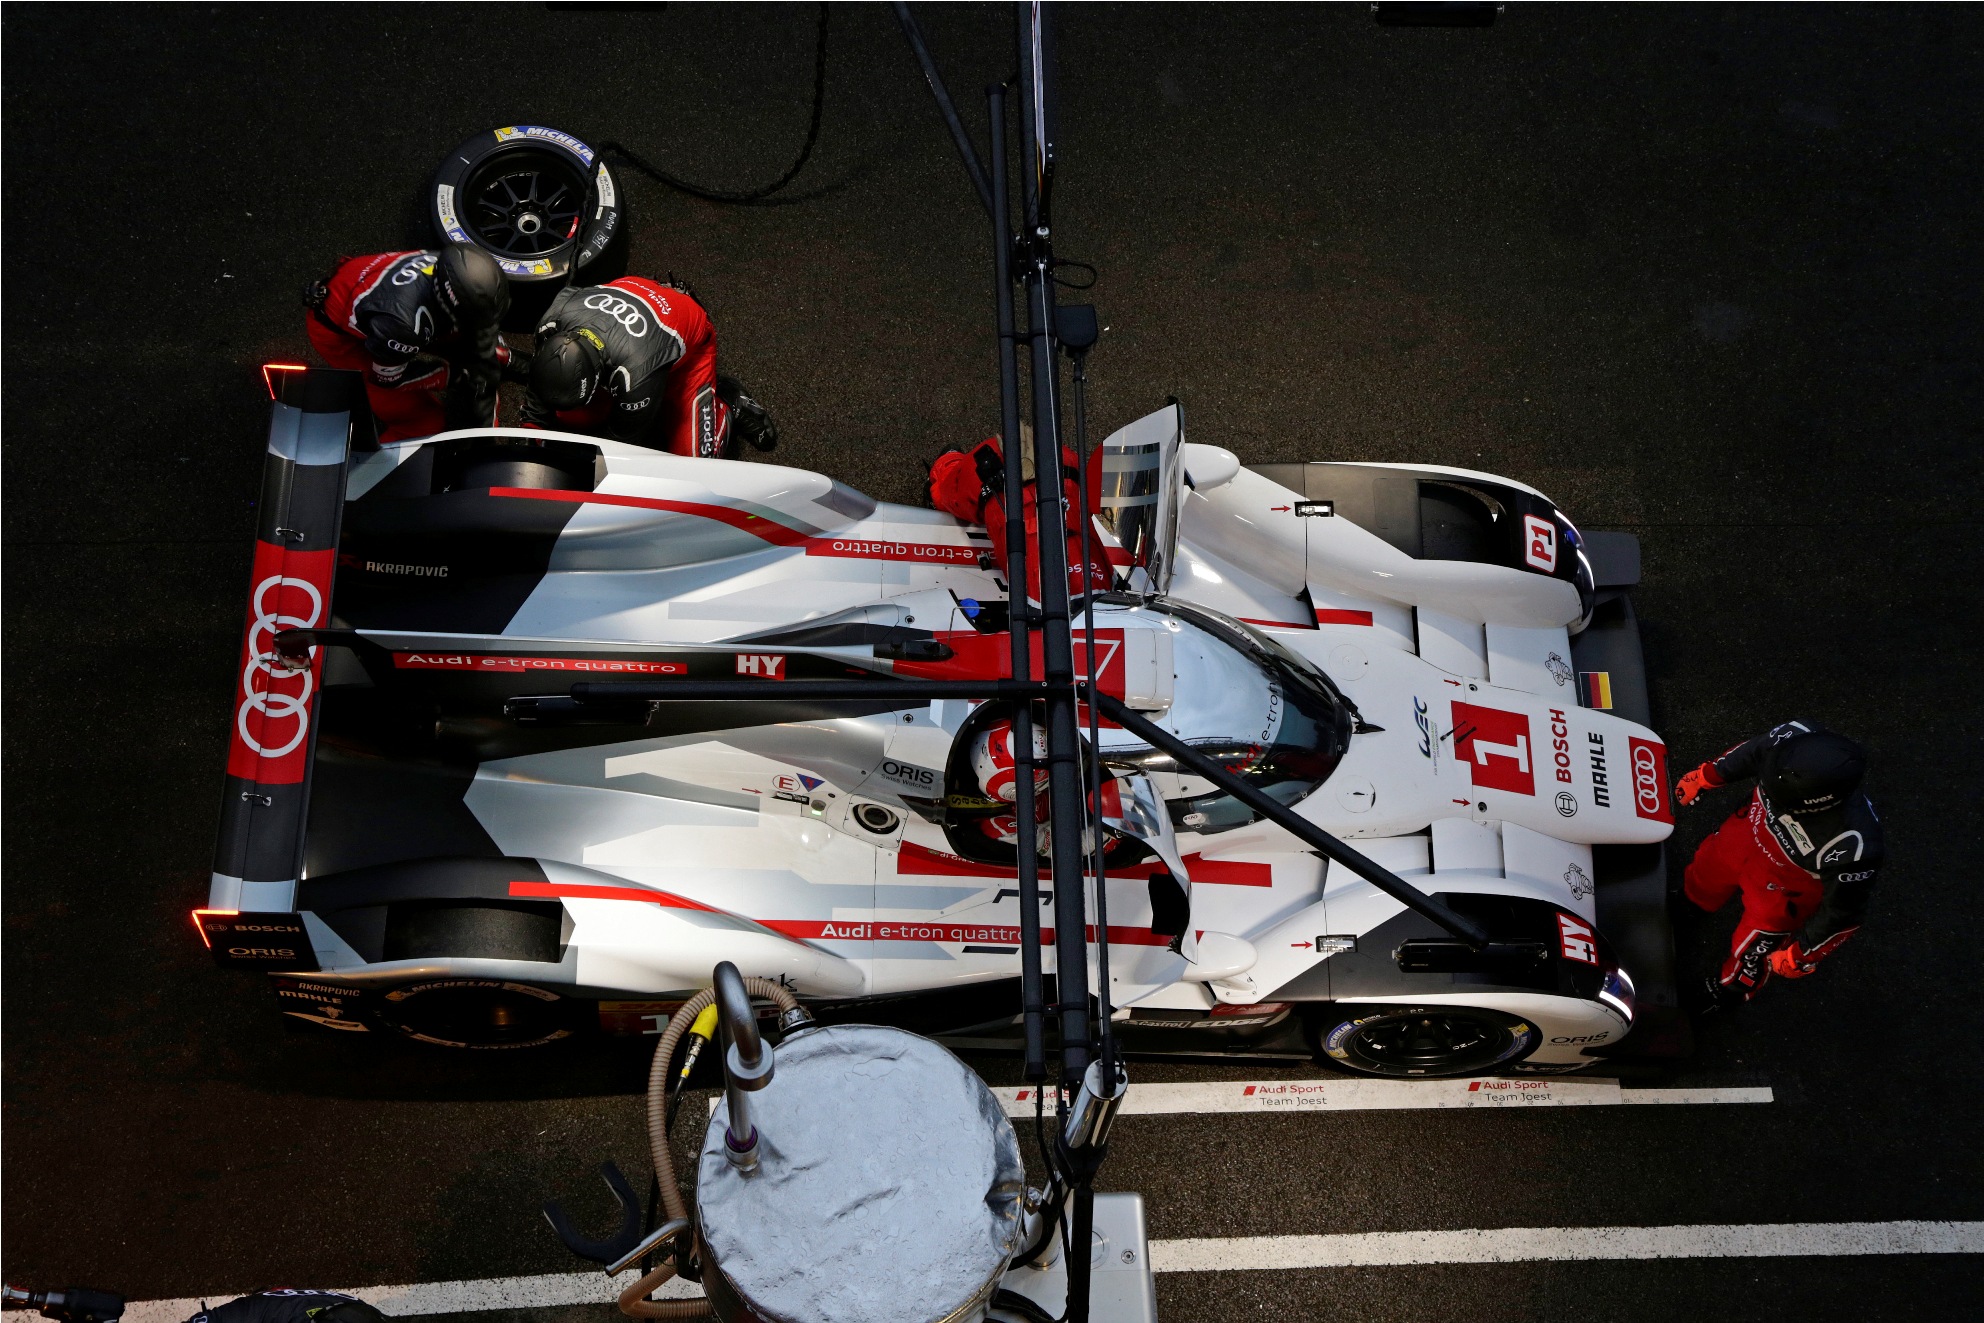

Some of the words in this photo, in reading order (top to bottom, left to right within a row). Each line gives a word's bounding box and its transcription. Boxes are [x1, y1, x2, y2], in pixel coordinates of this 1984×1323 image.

[701, 404, 714, 455] Sport
[833, 541, 907, 555] quattro
[914, 546, 974, 559] e-tron
[1531, 525, 1552, 563] P1
[406, 654, 472, 665] Audi
[482, 657, 565, 669] e-tron
[574, 661, 677, 672] quattro
[737, 655, 784, 676] HY
[1261, 682, 1280, 741] e-tron
[1472, 734, 1530, 774] 1
[1549, 708, 1572, 783] BOSCH
[882, 761, 934, 785] ORIS
[1588, 732, 1610, 808] MAHLE
[1803, 794, 1835, 805] uvex
[1773, 826, 1797, 856] Sport
[234, 924, 300, 933] BOSCH
[820, 923, 872, 938] Audi
[880, 926, 944, 939] e-tron
[1559, 914, 1596, 964] HY
[228, 947, 295, 956] ORIS
[411, 981, 501, 993] MICHELIN
[279, 990, 343, 1005] MAHLE
[1551, 1031, 1609, 1043] ORIS
[1259, 1085, 1287, 1094] Audi
[1289, 1085, 1324, 1096] Sport
[1483, 1080, 1511, 1089] Audi
[1514, 1080, 1549, 1091] Sport
[1259, 1097, 1294, 1106] Team
[1296, 1096, 1328, 1108] Joest
[1484, 1093, 1517, 1102] Team
[1519, 1092, 1552, 1103] Joest
